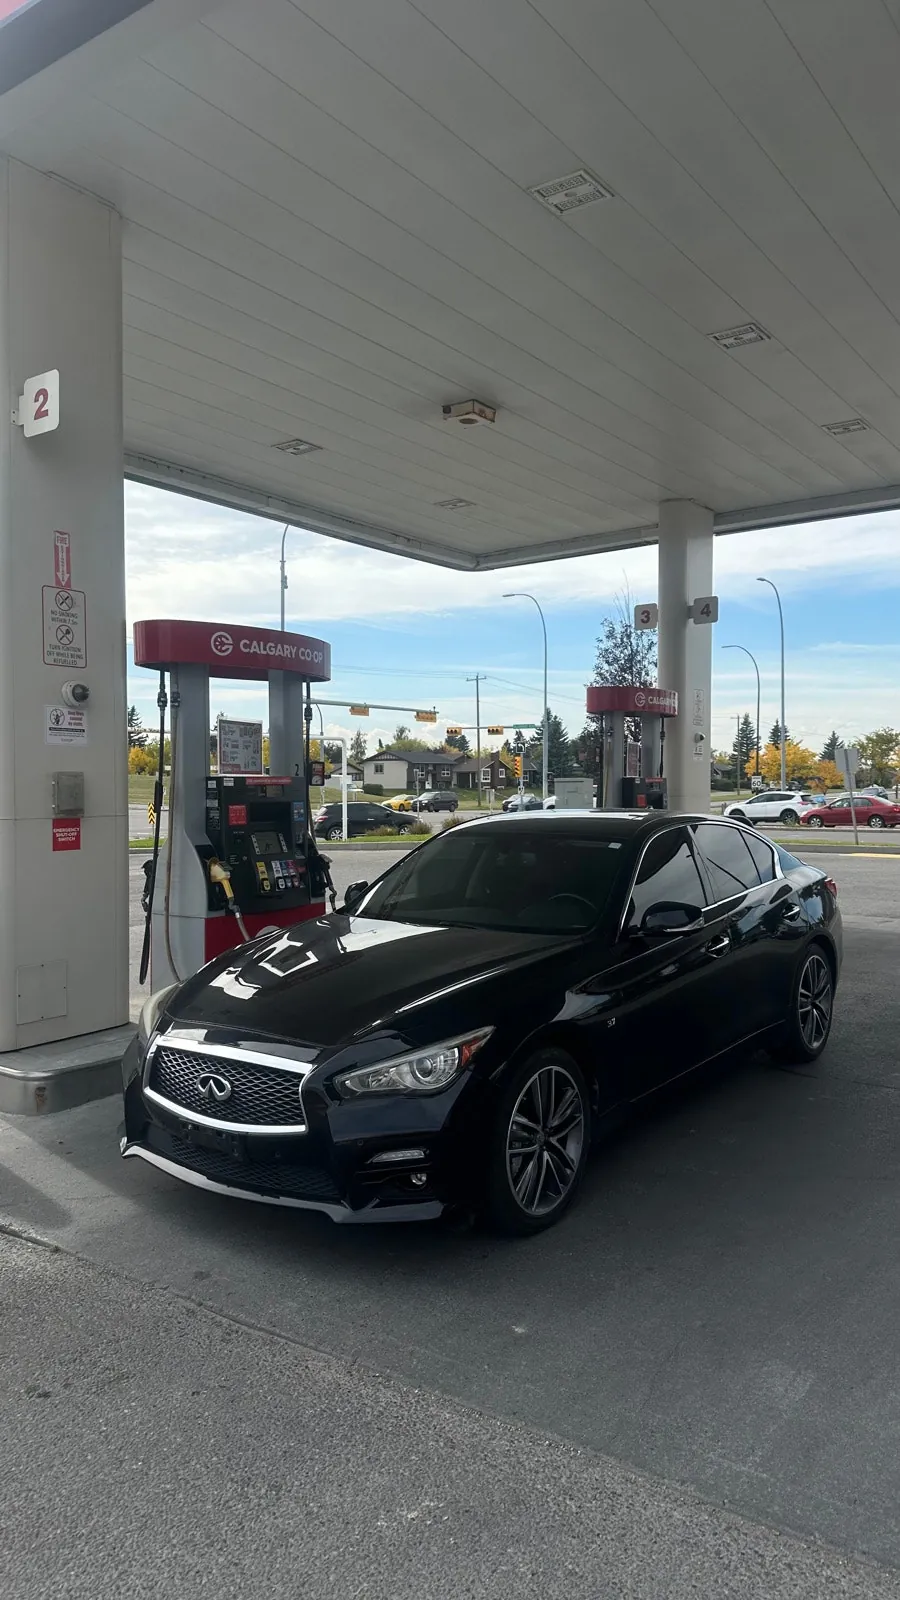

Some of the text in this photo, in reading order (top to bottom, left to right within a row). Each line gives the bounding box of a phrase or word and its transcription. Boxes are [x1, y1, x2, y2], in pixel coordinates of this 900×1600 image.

[33, 388, 49, 421] 2
[640, 609, 651, 624] 3
[700, 603, 712, 618] 4
[239, 638, 297, 659] CALGARY
[295, 763, 300, 776] 2
